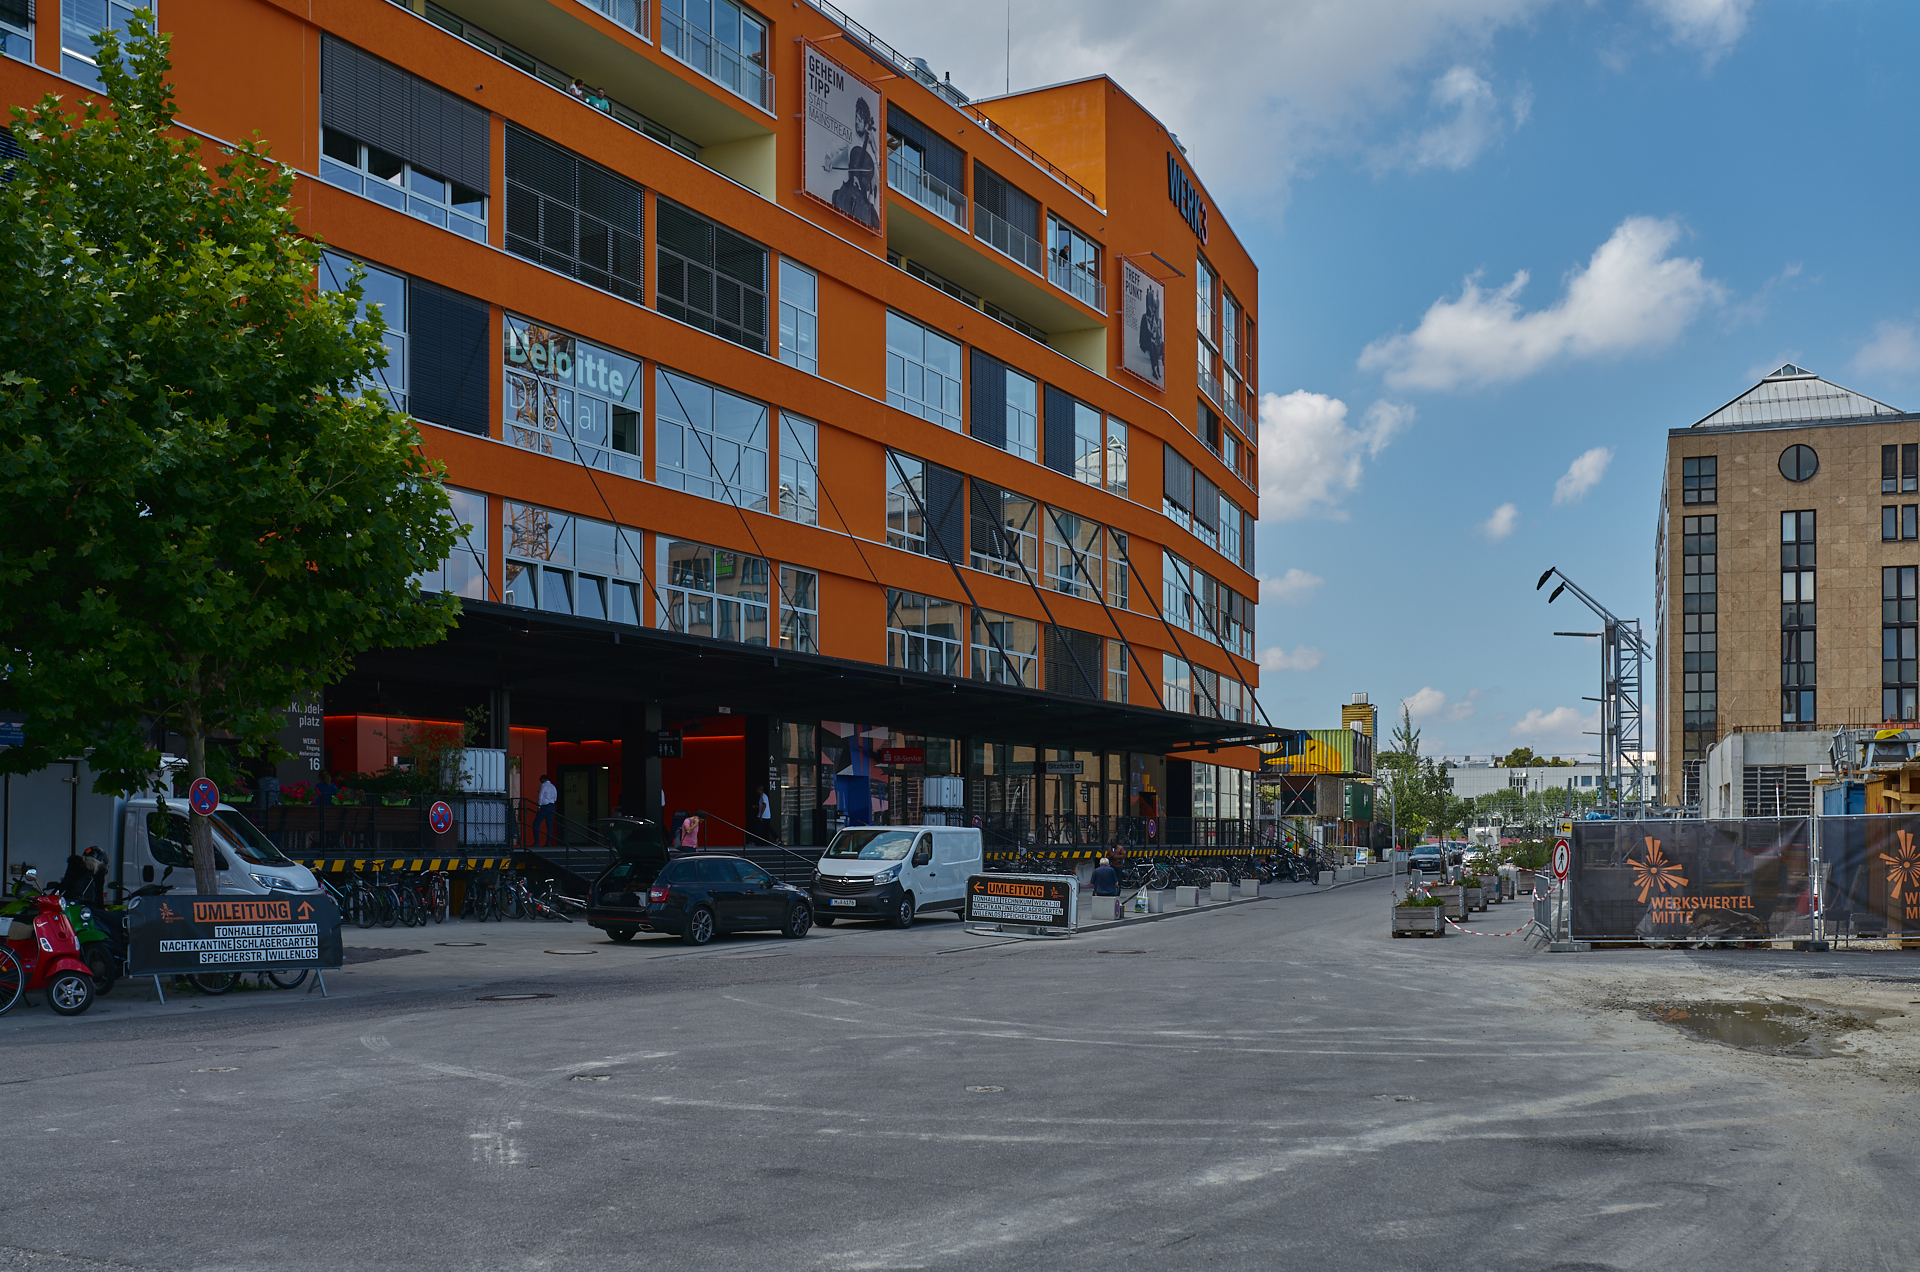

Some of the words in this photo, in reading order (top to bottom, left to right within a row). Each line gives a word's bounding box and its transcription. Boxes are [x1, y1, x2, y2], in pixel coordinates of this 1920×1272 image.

[809, 55, 844, 91] GEHEIM
[809, 73, 829, 98] TIPP
[809, 92, 828, 112] STATT
[809, 107, 852, 142] MAINSTREAM
[1167, 151, 1208, 246] WERK3
[1126, 267, 1140, 286] TREFF
[1126, 281, 1142, 301] PUNKT
[509, 328, 623, 396] Deloitte
[510, 374, 596, 432] Digital
[299, 715, 320, 728] platz
[309, 757, 320, 770] 16
[893, 754, 922, 762] SB-Service
[769, 781, 776, 791] 14
[989, 883, 1043, 896] UMLEITUNG
[974, 895, 1000, 903] TONHALLE
[1001, 897, 1032, 905] TECHNIKUM
[1651, 896, 1755, 910] WERKSVIERTEL
[196, 902, 288, 921] UMLEITUNG
[973, 902, 1014, 911] NACHTKANTINE
[1014, 906, 1062, 914] SCHLAGERGARTEN
[1003, 913, 1052, 921] SPEICHERSTRASSE
[1652, 911, 1695, 924] MITTE
[216, 926, 262, 937] TONHALLE
[264, 924, 317, 935] TECHNIKUM
[161, 939, 232, 951] NACHTKANTINE
[236, 937, 316, 949] SCHLAGERGARTEN
[201, 952, 265, 963] SPEICHERSTR.
[268, 949, 317, 960] WILLENLOS
